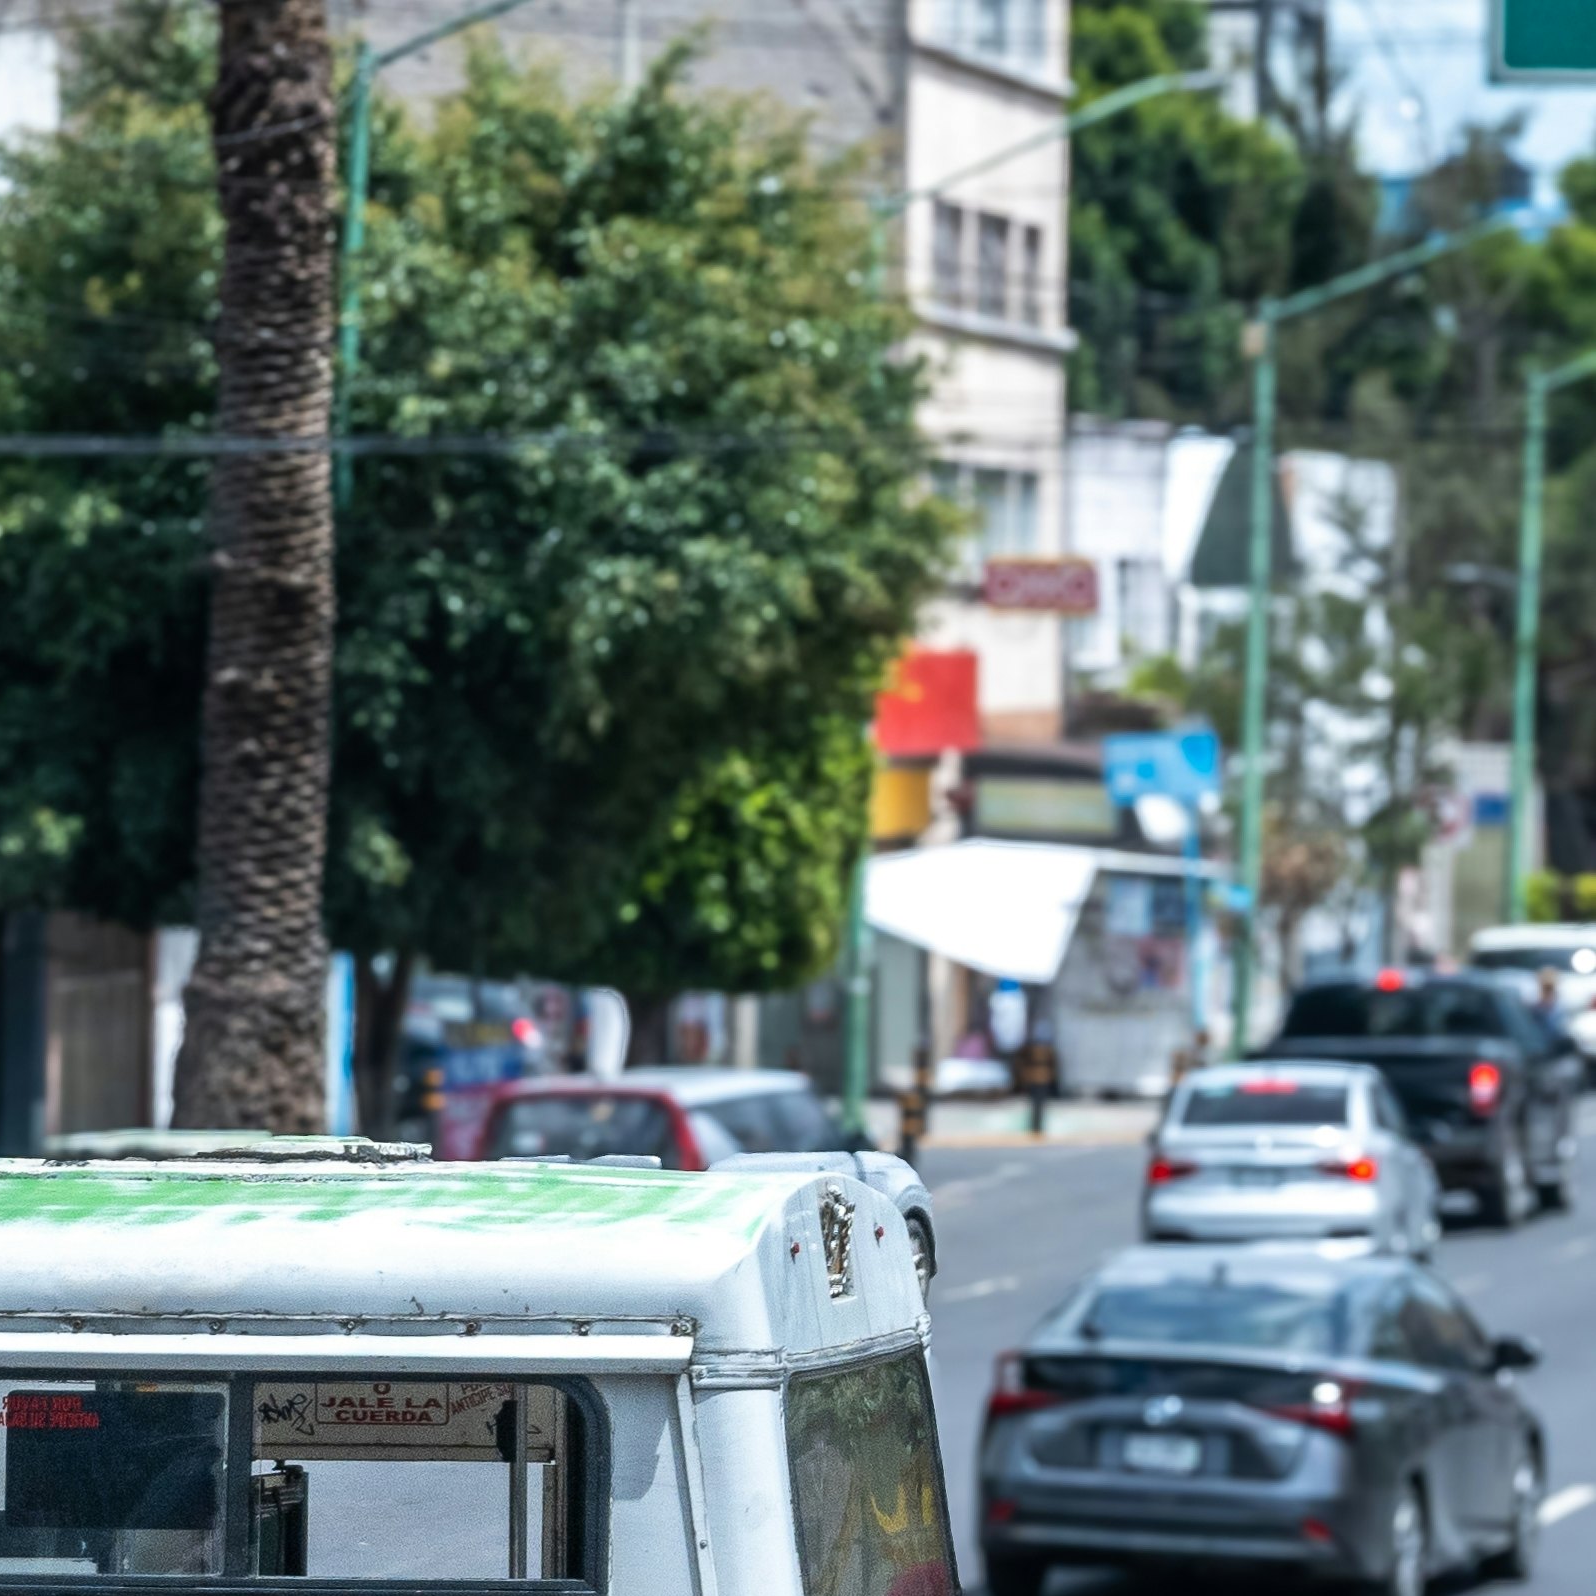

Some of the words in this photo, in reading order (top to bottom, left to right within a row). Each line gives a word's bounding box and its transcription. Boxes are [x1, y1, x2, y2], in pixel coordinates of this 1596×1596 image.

[319, 1396, 397, 1410] JALE
[405, 1396, 444, 1410] LA
[334, 1409, 434, 1423] CUERDA
